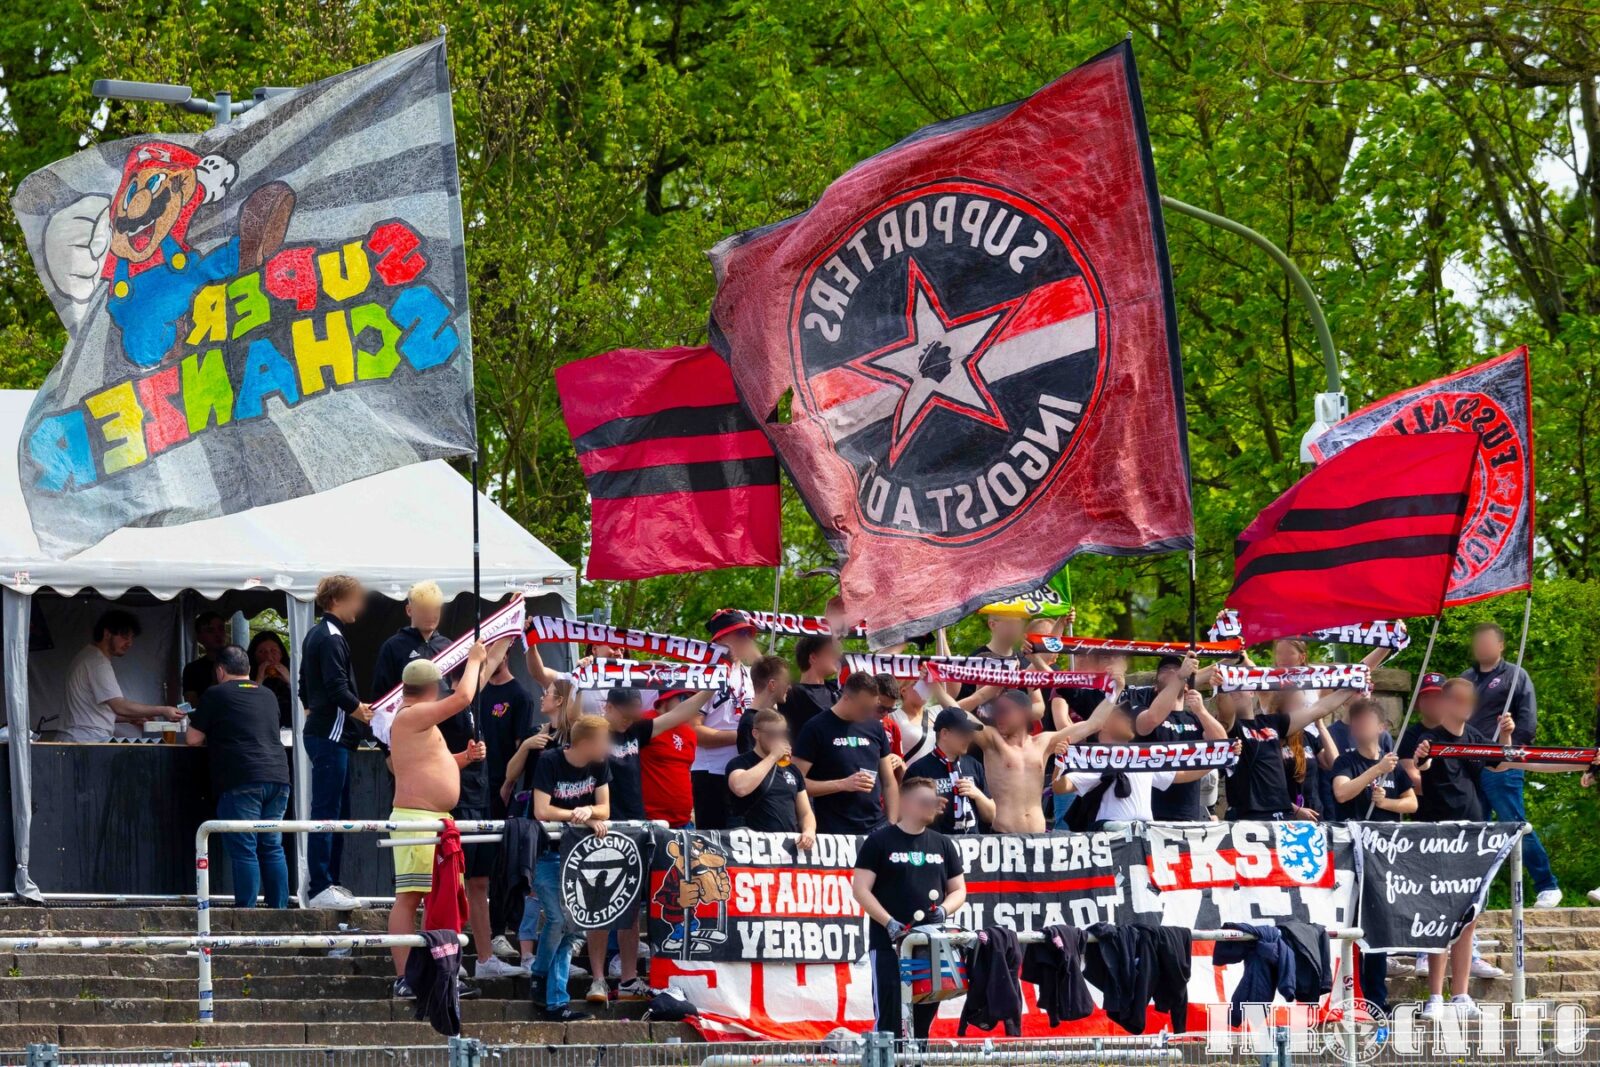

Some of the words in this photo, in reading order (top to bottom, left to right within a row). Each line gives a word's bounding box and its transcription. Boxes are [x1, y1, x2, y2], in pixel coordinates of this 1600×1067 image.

[1066, 741, 1229, 770] NGOLSTAD
[567, 850, 583, 870] IN
[582, 835, 638, 866] KOGNITO
[729, 828, 858, 868] SEKTION
[950, 831, 1114, 874] PORTERS
[1150, 821, 1273, 886] FKS
[1420, 829, 1469, 854] und
[734, 871, 861, 916] STADION
[1385, 870, 1423, 904] für
[1430, 874, 1483, 895] imm
[736, 920, 860, 961] VERBOT
[1410, 912, 1449, 938] bei
